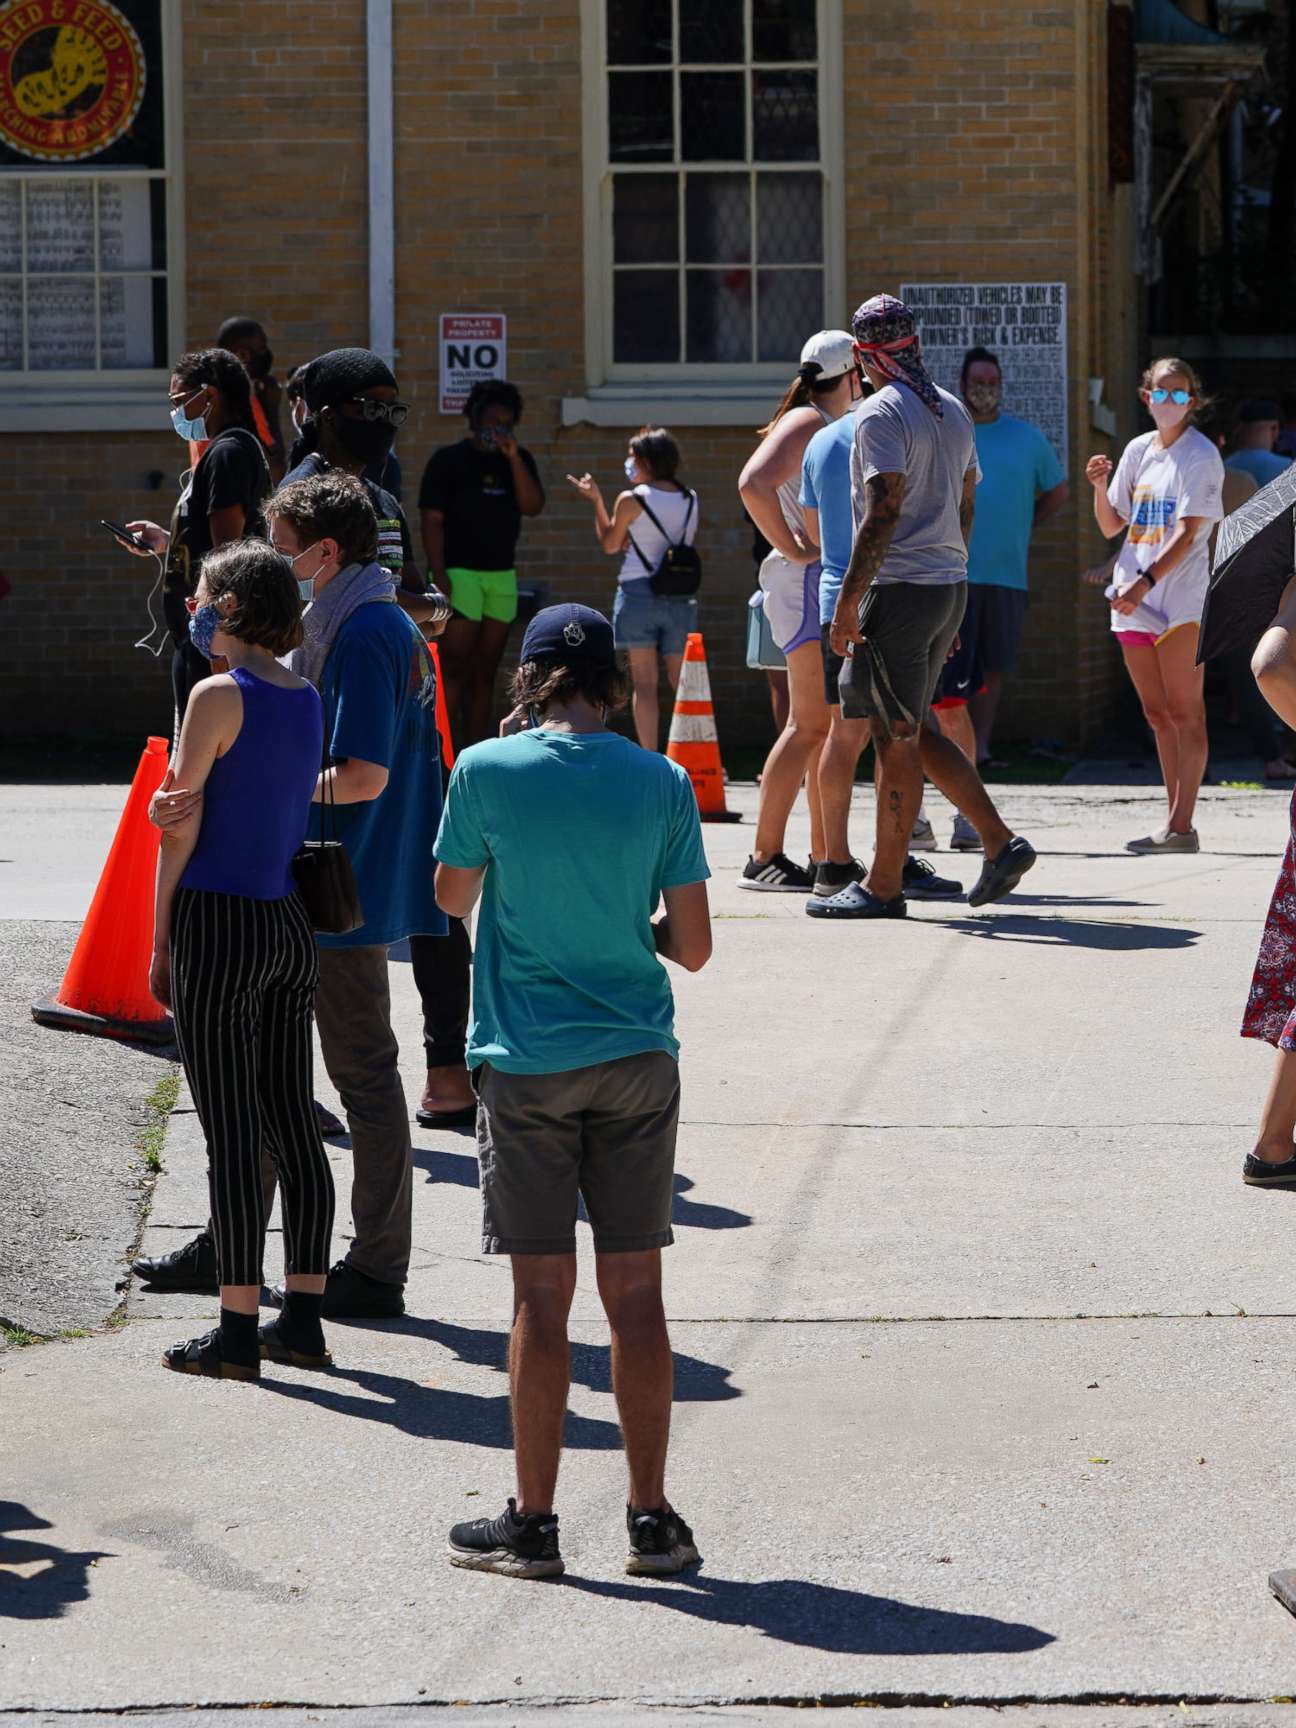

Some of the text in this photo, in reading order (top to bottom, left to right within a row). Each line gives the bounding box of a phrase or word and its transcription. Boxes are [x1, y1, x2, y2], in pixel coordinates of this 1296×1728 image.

[0, 0, 122, 52] SEED & FEED
[903, 286, 1063, 305] UNAUTHORIZED VEHICLES MAY BE
[452, 320, 492, 328] PRIVATE
[1005, 307, 1018, 325] OR
[448, 329, 497, 337] PROPERTY
[922, 327, 968, 346] OWNER'S
[972, 327, 997, 345] RISK
[1000, 327, 1009, 345] &
[447, 344, 499, 369] NO
